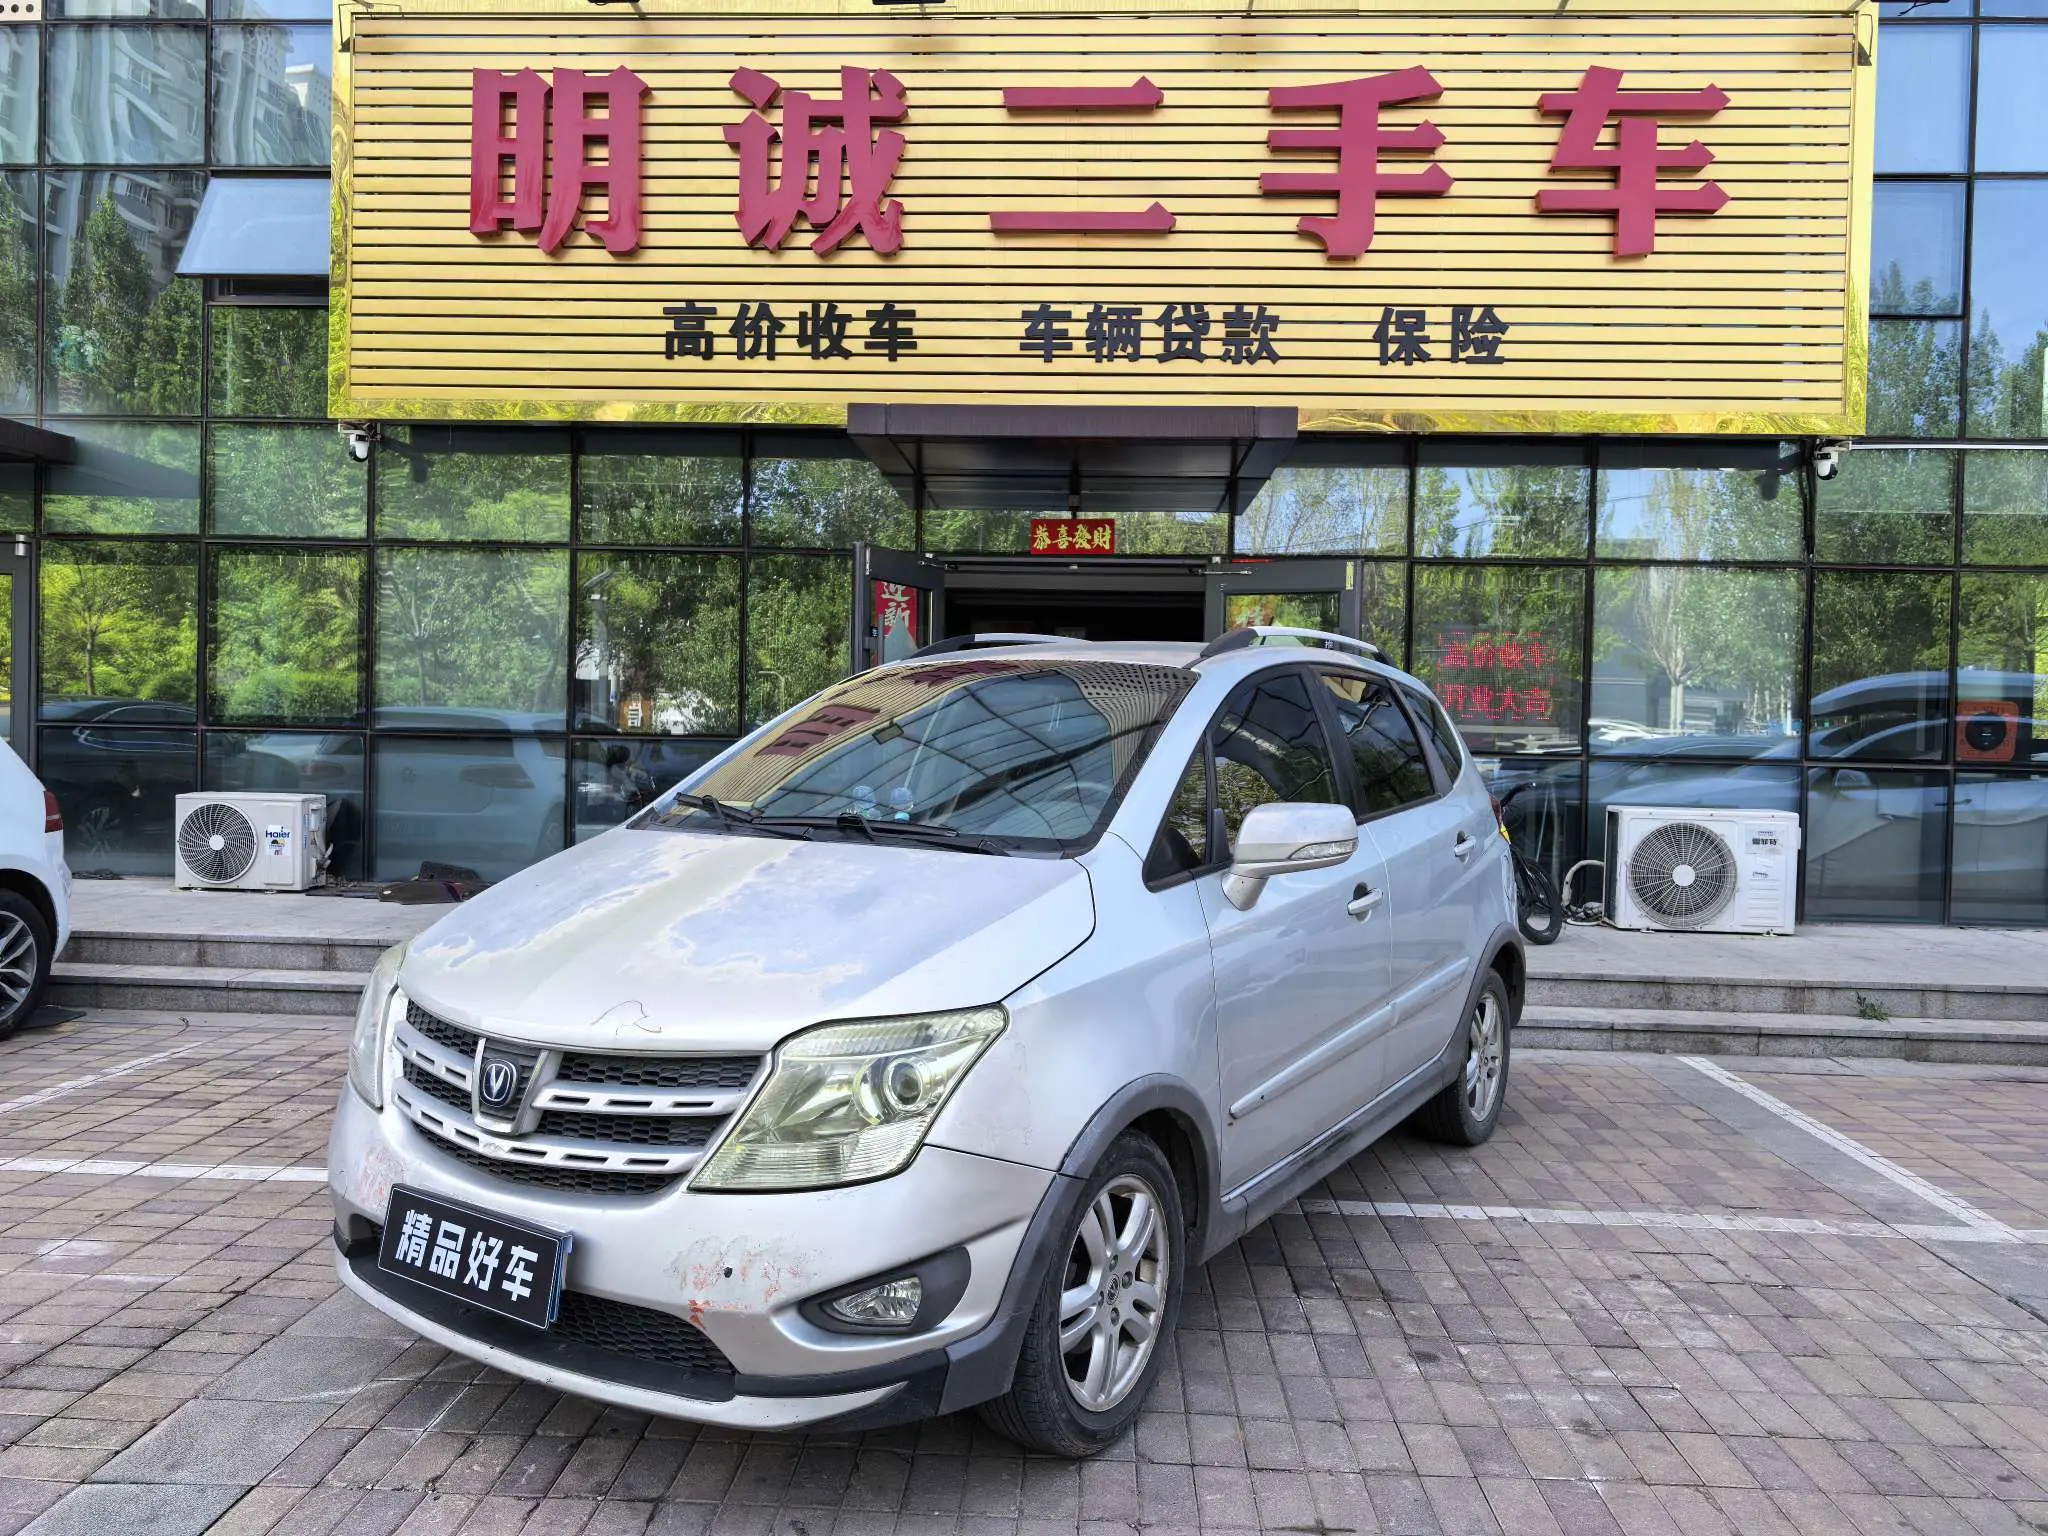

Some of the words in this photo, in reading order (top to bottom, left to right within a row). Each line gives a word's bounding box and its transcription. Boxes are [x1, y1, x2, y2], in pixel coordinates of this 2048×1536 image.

[471, 64, 1730, 261] 明诚二手车
[663, 302, 917, 362] 高价收车
[1020, 303, 1281, 365] 车辆贷款
[1373, 306, 1510, 366] 保险
[1033, 524, 1112, 550] 恭喜發財
[1442, 684, 1554, 713] 开业大吉
[265, 826, 291, 839] Haier
[394, 1209, 539, 1302] 精品好车
